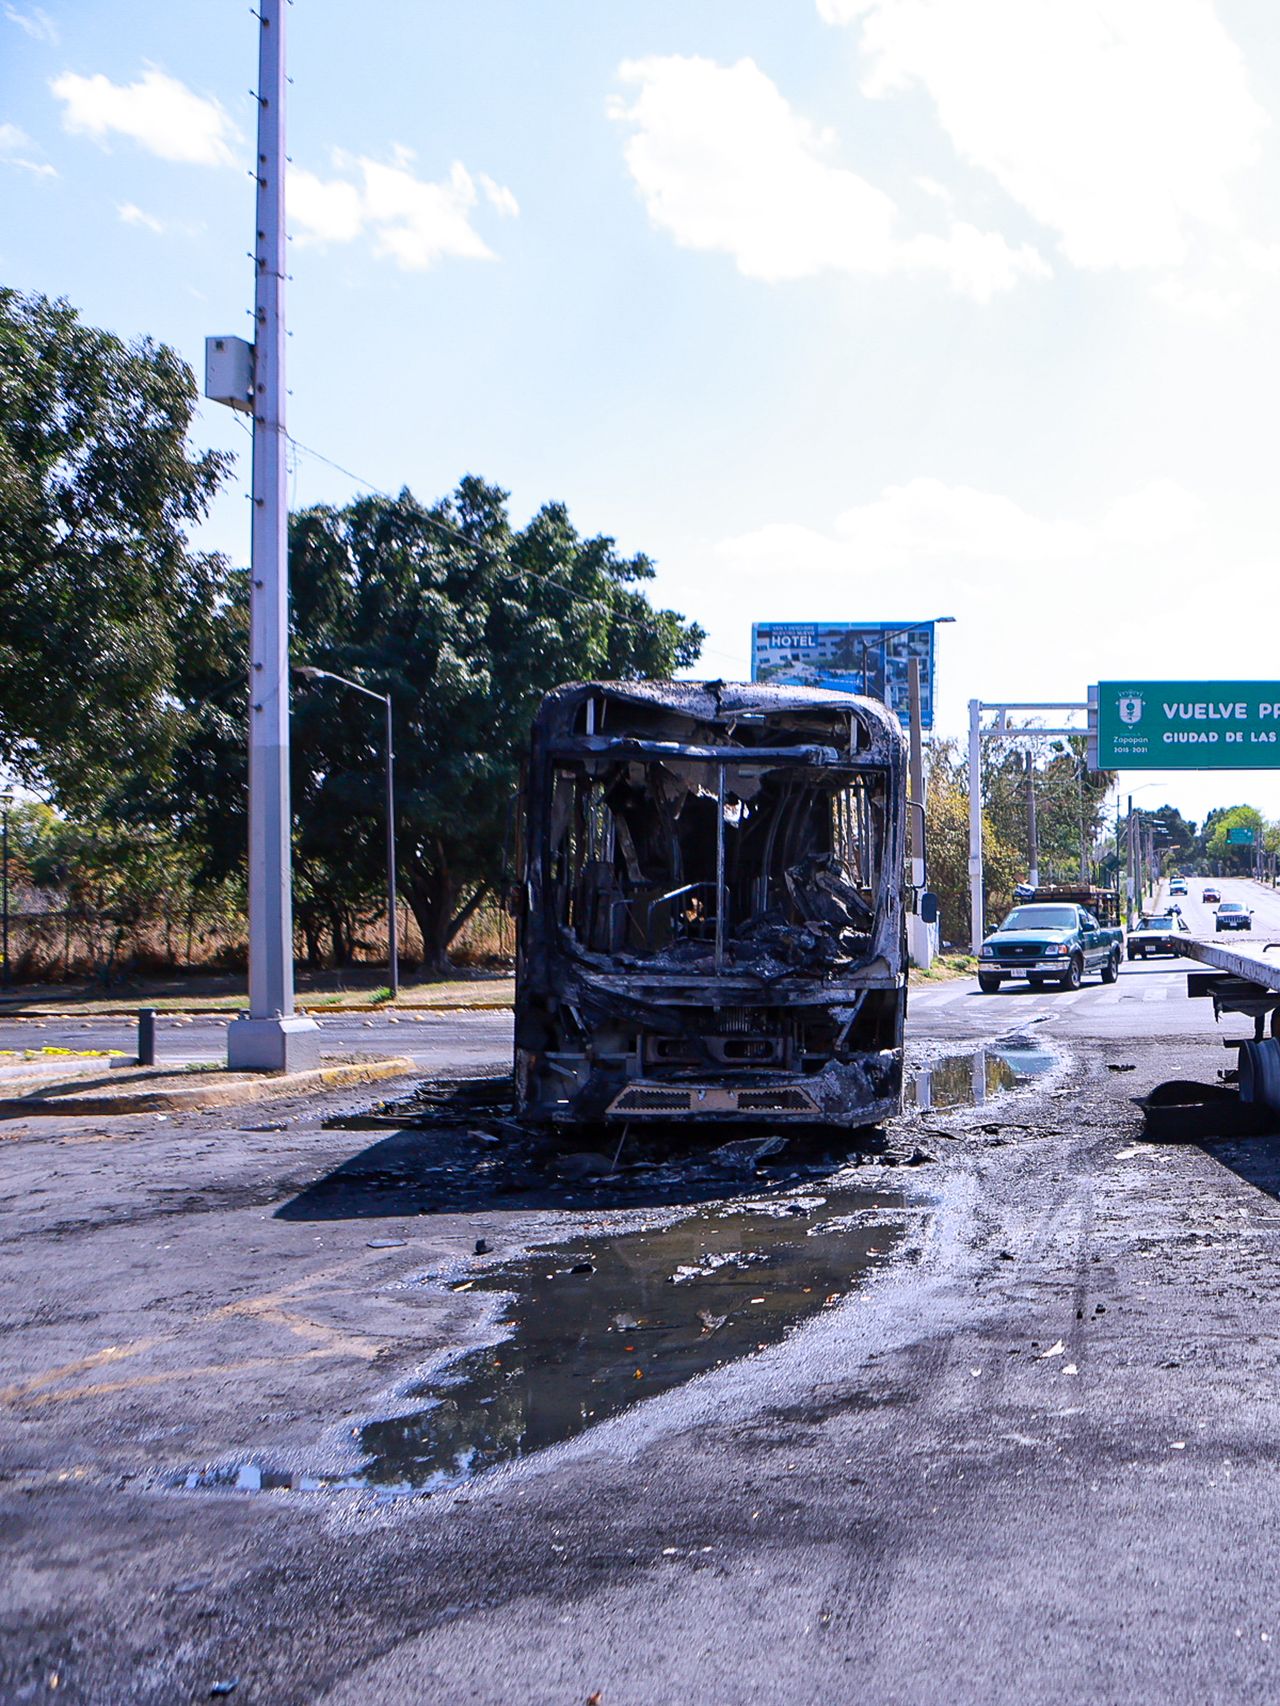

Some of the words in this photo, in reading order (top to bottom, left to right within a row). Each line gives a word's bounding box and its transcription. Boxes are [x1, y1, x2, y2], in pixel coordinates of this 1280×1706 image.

[771, 635, 816, 647] HOTEL
[1163, 702, 1247, 719] VUELVE
[1113, 736, 1149, 745] Zapopan
[1163, 730, 1219, 743] CIUDAD
[1225, 731, 1243, 742] DE
[1250, 731, 1277, 742] LAS
